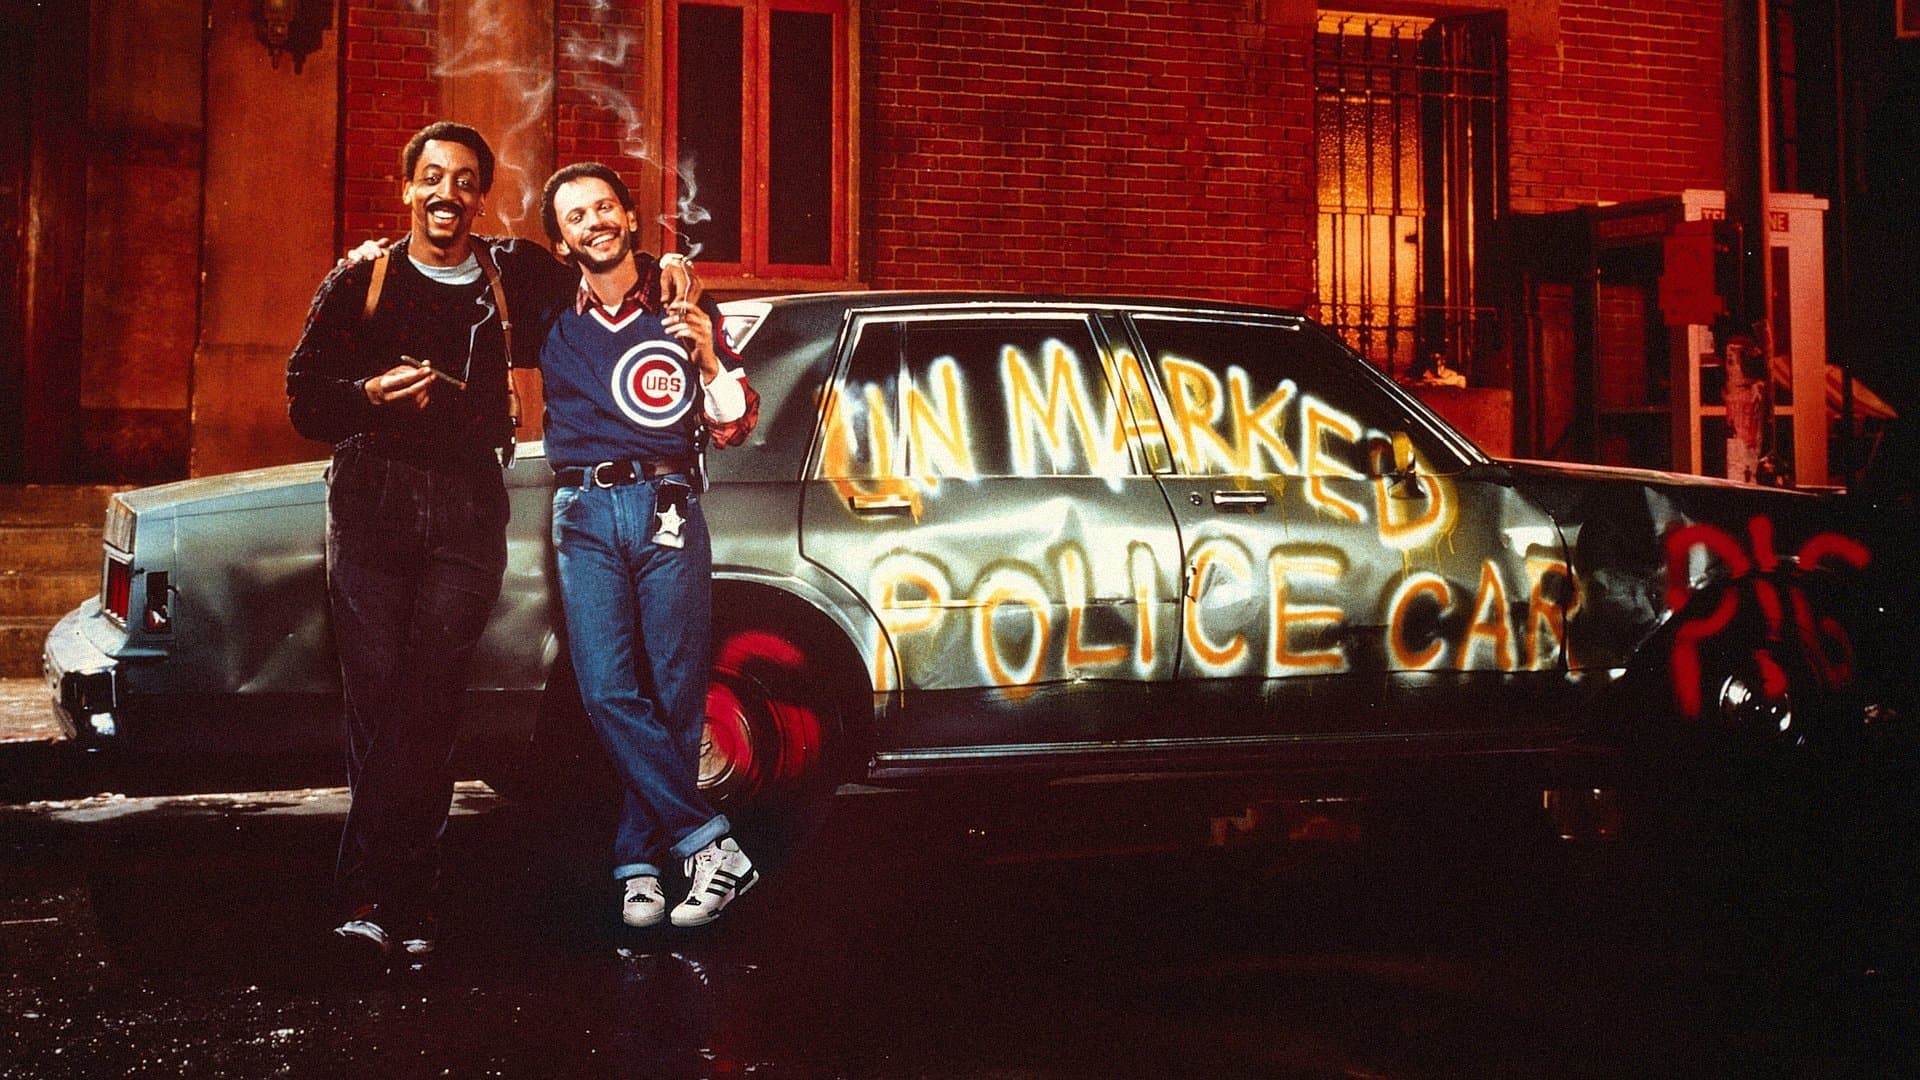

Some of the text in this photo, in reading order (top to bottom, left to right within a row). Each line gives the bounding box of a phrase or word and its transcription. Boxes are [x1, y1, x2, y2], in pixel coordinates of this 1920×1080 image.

[633, 359, 681, 408] CUBS
[817, 339, 1456, 549] UN MARKED
[869, 541, 1582, 703] POLICE CAR
